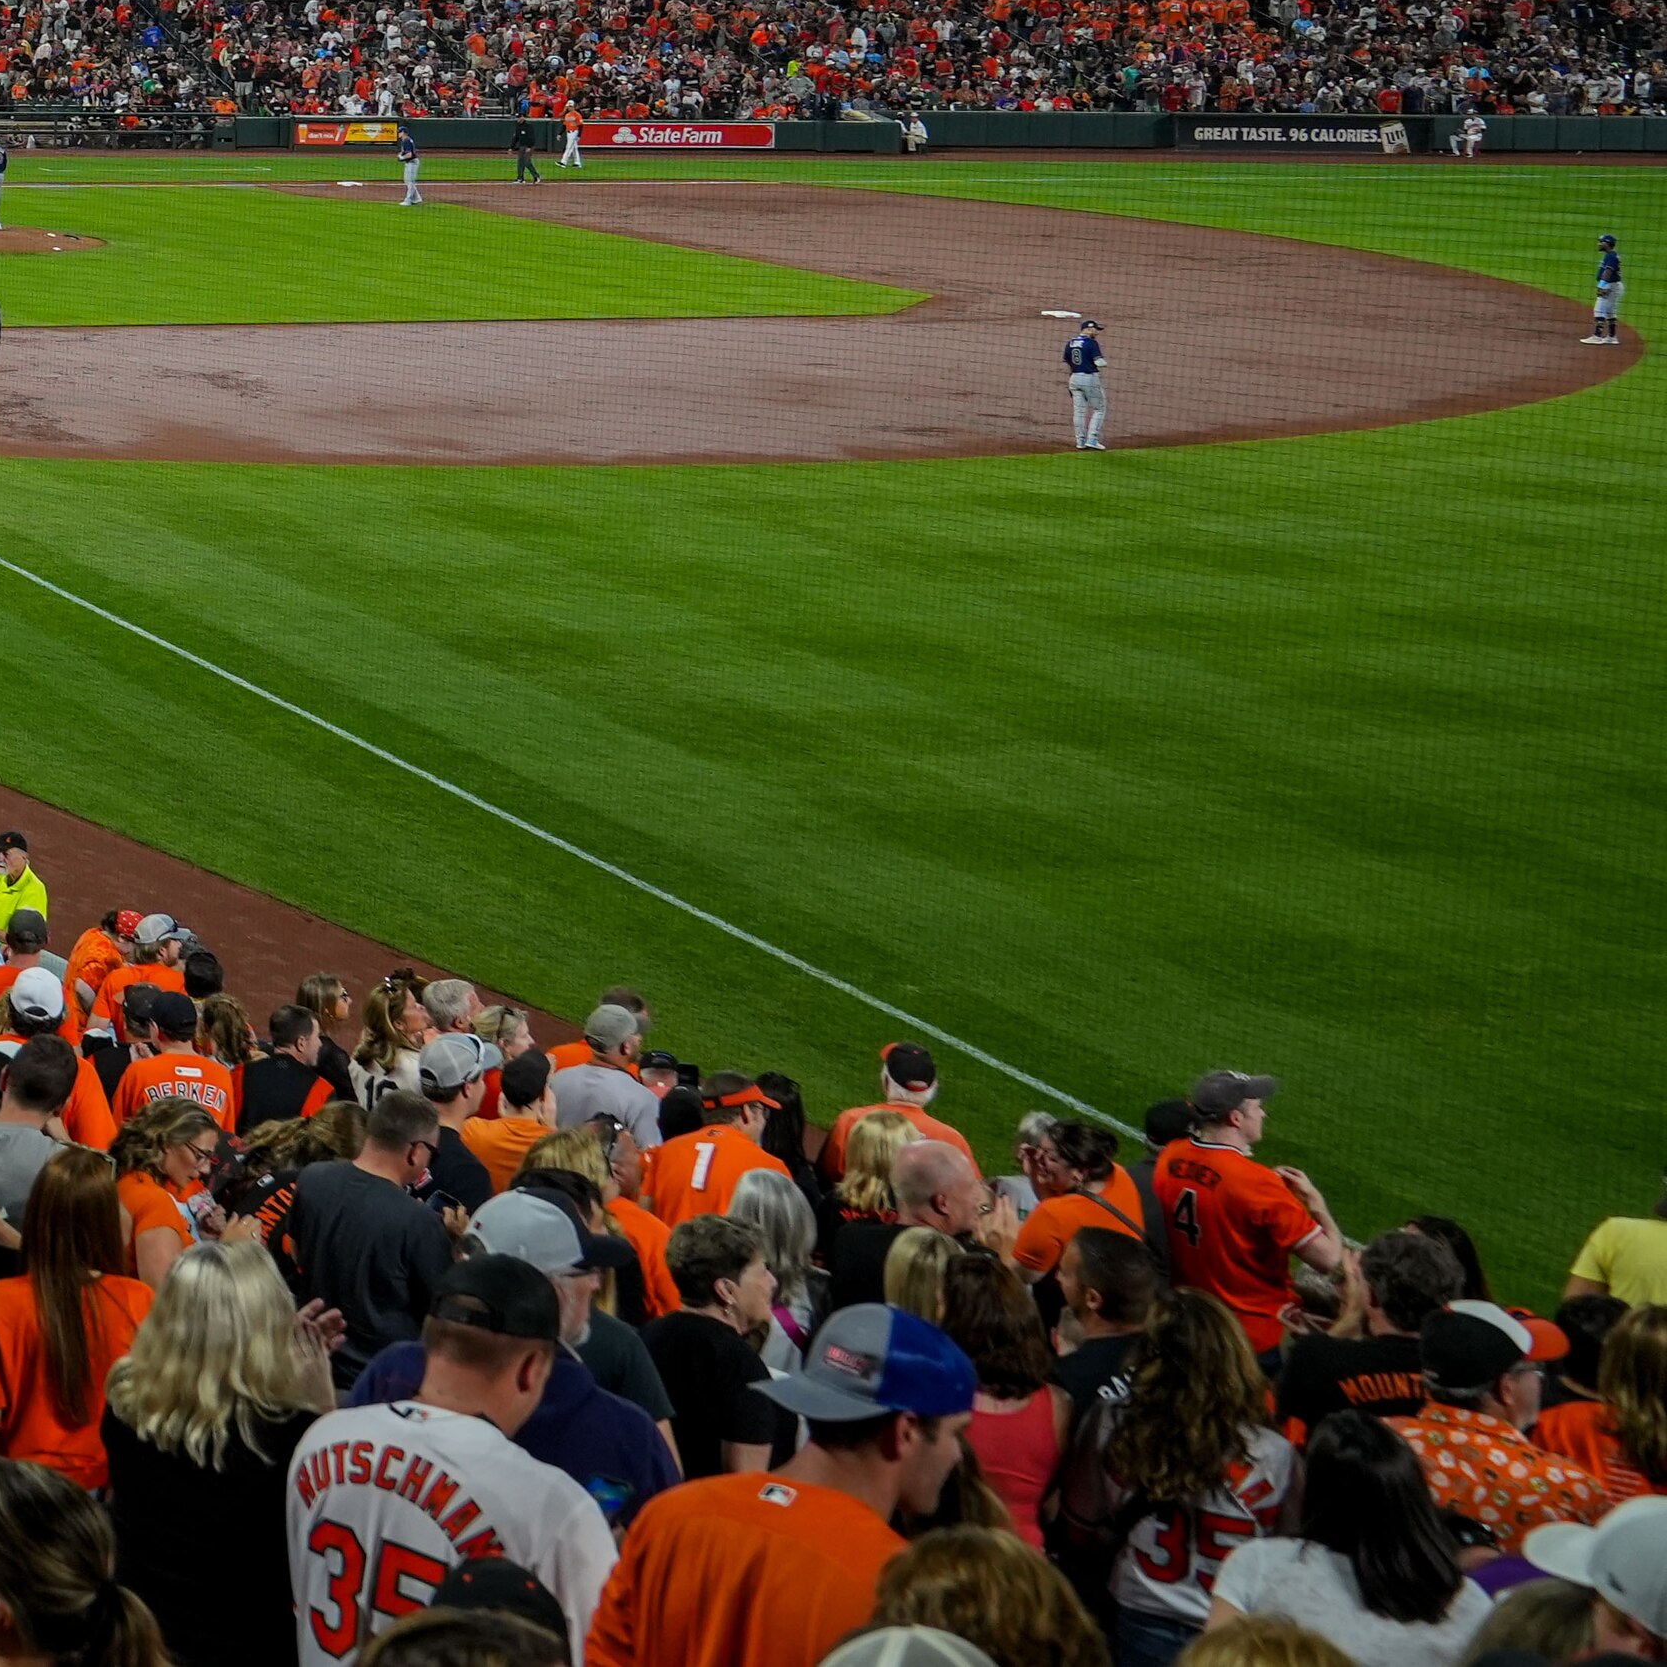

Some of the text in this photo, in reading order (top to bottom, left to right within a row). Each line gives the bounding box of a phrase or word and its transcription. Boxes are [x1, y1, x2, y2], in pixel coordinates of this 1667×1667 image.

[1194, 127, 1382, 143] GREAT TASTE. 96 CALORIES.
[690, 1142, 715, 1191] 1
[1173, 1188, 1202, 1248] 4
[296, 1440, 506, 1560] RUTSCHMAN
[309, 1520, 449, 1659] 35
